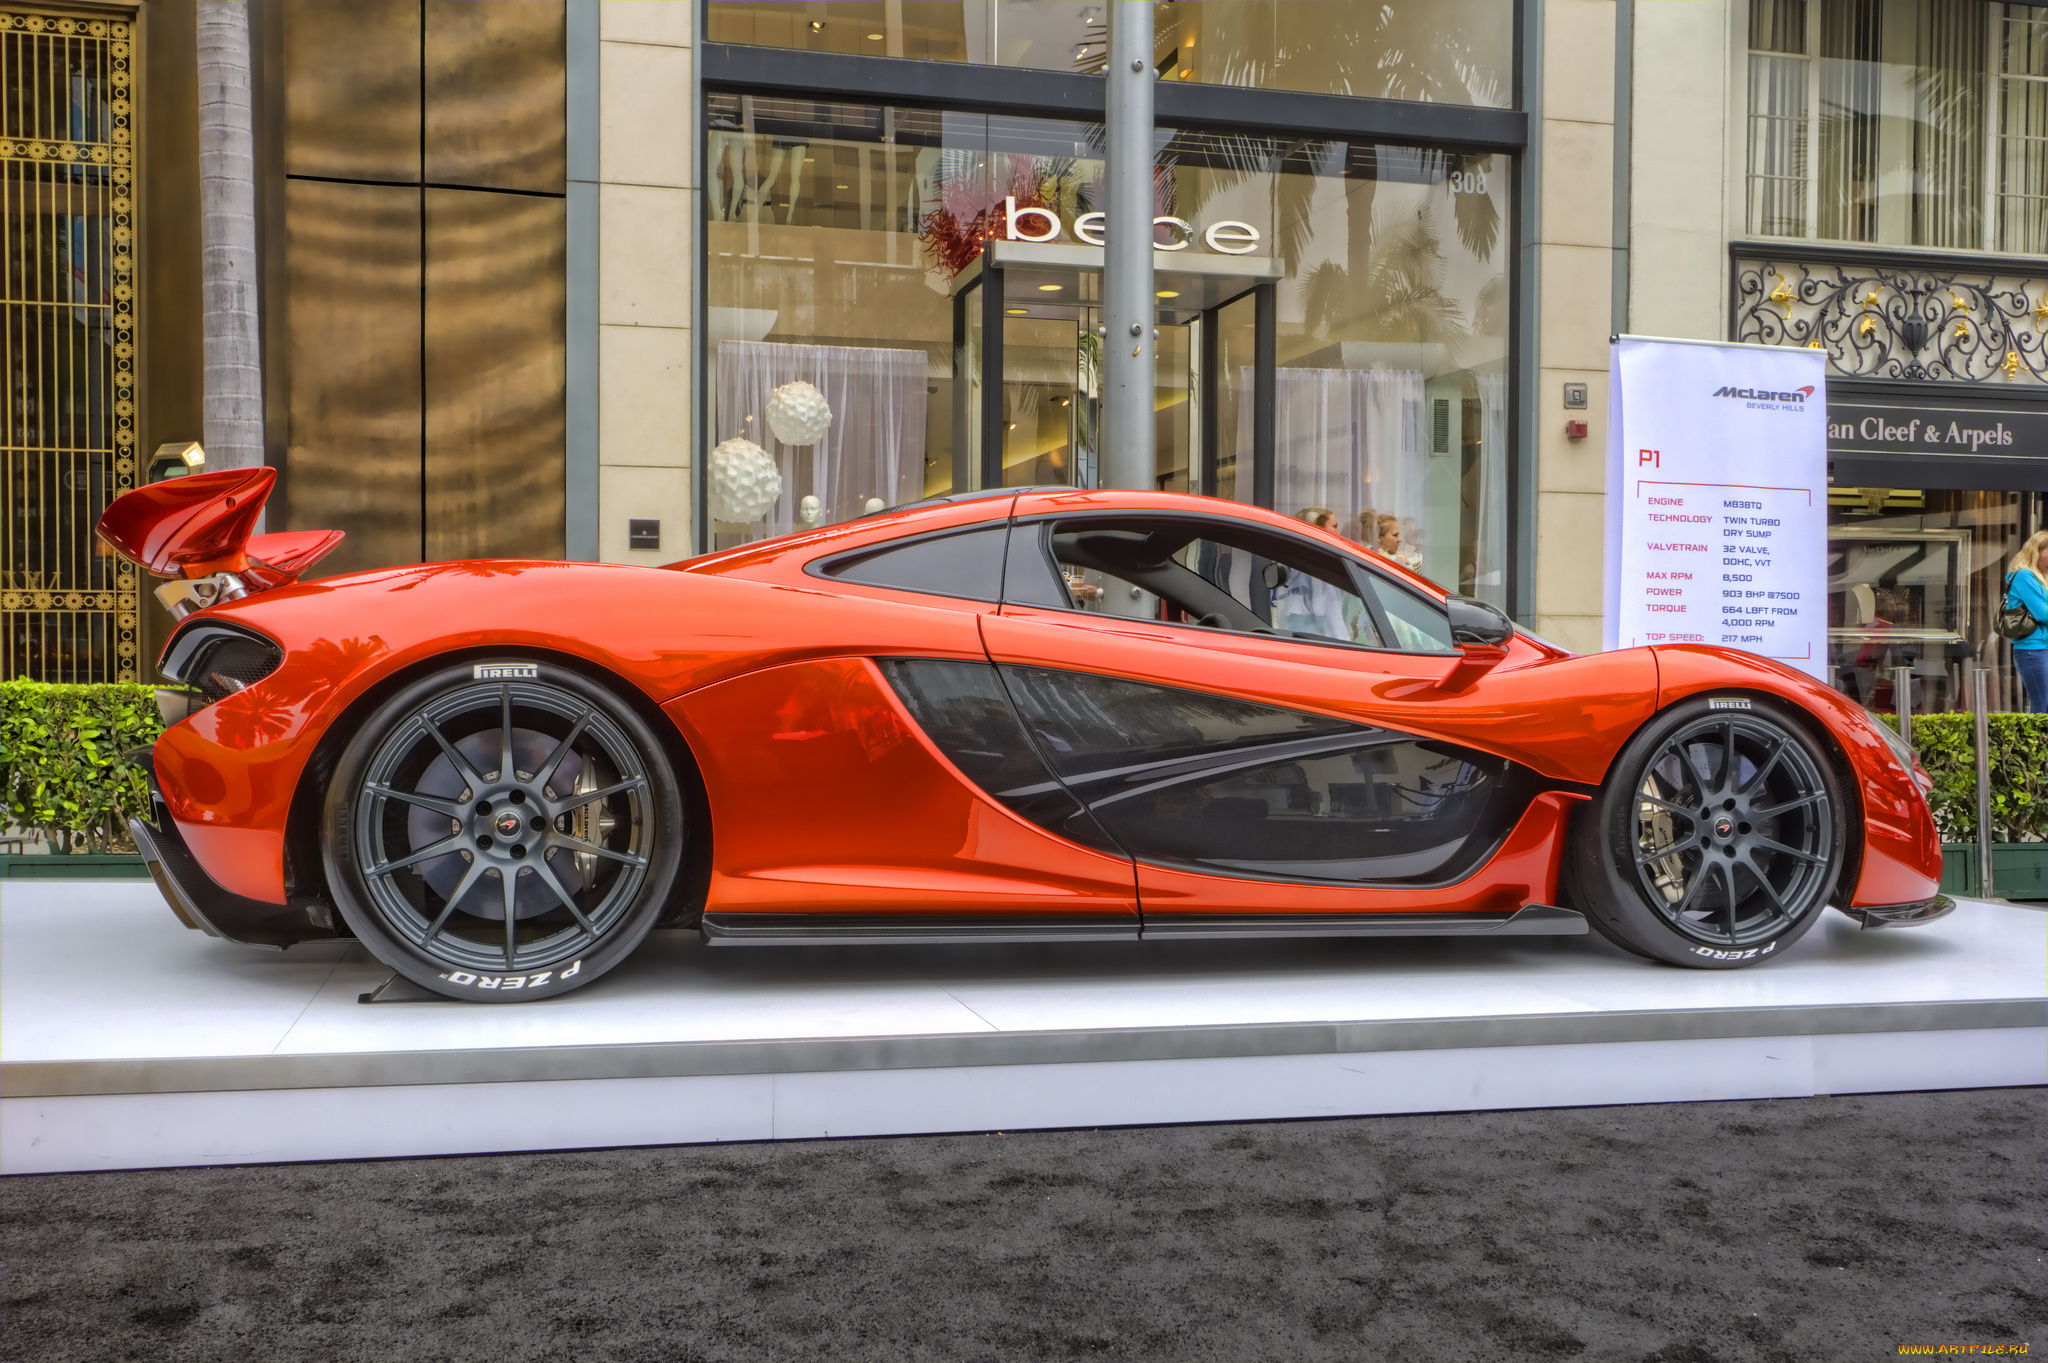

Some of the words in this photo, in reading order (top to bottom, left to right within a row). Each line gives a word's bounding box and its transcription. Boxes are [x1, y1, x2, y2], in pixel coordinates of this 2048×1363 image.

[1451, 170, 1488, 195] 308
[1712, 386, 1805, 404] McLaren
[1746, 402, 1780, 411] BEVERLY
[1782, 404, 1805, 412] HILLS
[1827, 416, 1854, 440] an
[1860, 417, 1920, 442] Cleef
[1924, 425, 1941, 443] &
[1945, 421, 2013, 452] Arpels
[1639, 449, 1660, 468] P1
[1648, 497, 1684, 507] ENGINE
[1723, 500, 1762, 510] M838TQ
[1647, 513, 1713, 523] TECHNOLOGY
[1723, 516, 1747, 525] TWIN
[1750, 517, 1780, 527] TURBO
[1723, 529, 1744, 538] DRY
[1746, 530, 1772, 538] SUMP
[1647, 542, 1708, 552] VALVETRAIN
[1723, 545, 1736, 554] 32
[1738, 546, 1770, 555] VALVE,
[1723, 558, 1752, 567] DOHC,
[1754, 559, 1772, 567] VVT
[1646, 572, 1667, 580] MAX
[1670, 572, 1693, 580] RPM
[1722, 574, 1753, 583] 8,500
[1646, 588, 1682, 596] POWER
[1722, 590, 1743, 598] 903
[1745, 590, 1765, 598] BHP
[1768, 591, 1800, 600] @7500
[1646, 604, 1687, 613] TORQUE
[1722, 606, 1743, 614] 664
[1745, 607, 1769, 615] LBFT
[1771, 607, 1798, 616] FROM
[1721, 619, 1752, 628] 4,000
[1755, 619, 1775, 628] RPM
[1646, 633, 1667, 641] TOP
[1669, 633, 1705, 642] SPEED:
[1721, 634, 1738, 643] 217
[1740, 635, 1763, 643] MPH
[473, 662, 538, 679] PIRELLI
[1708, 697, 1751, 710] PIRELLI
[1761, 941, 1777, 954] P
[1695, 946, 1759, 960] ZERO
[560, 959, 581, 980] P
[447, 971, 552, 990] ZERO
